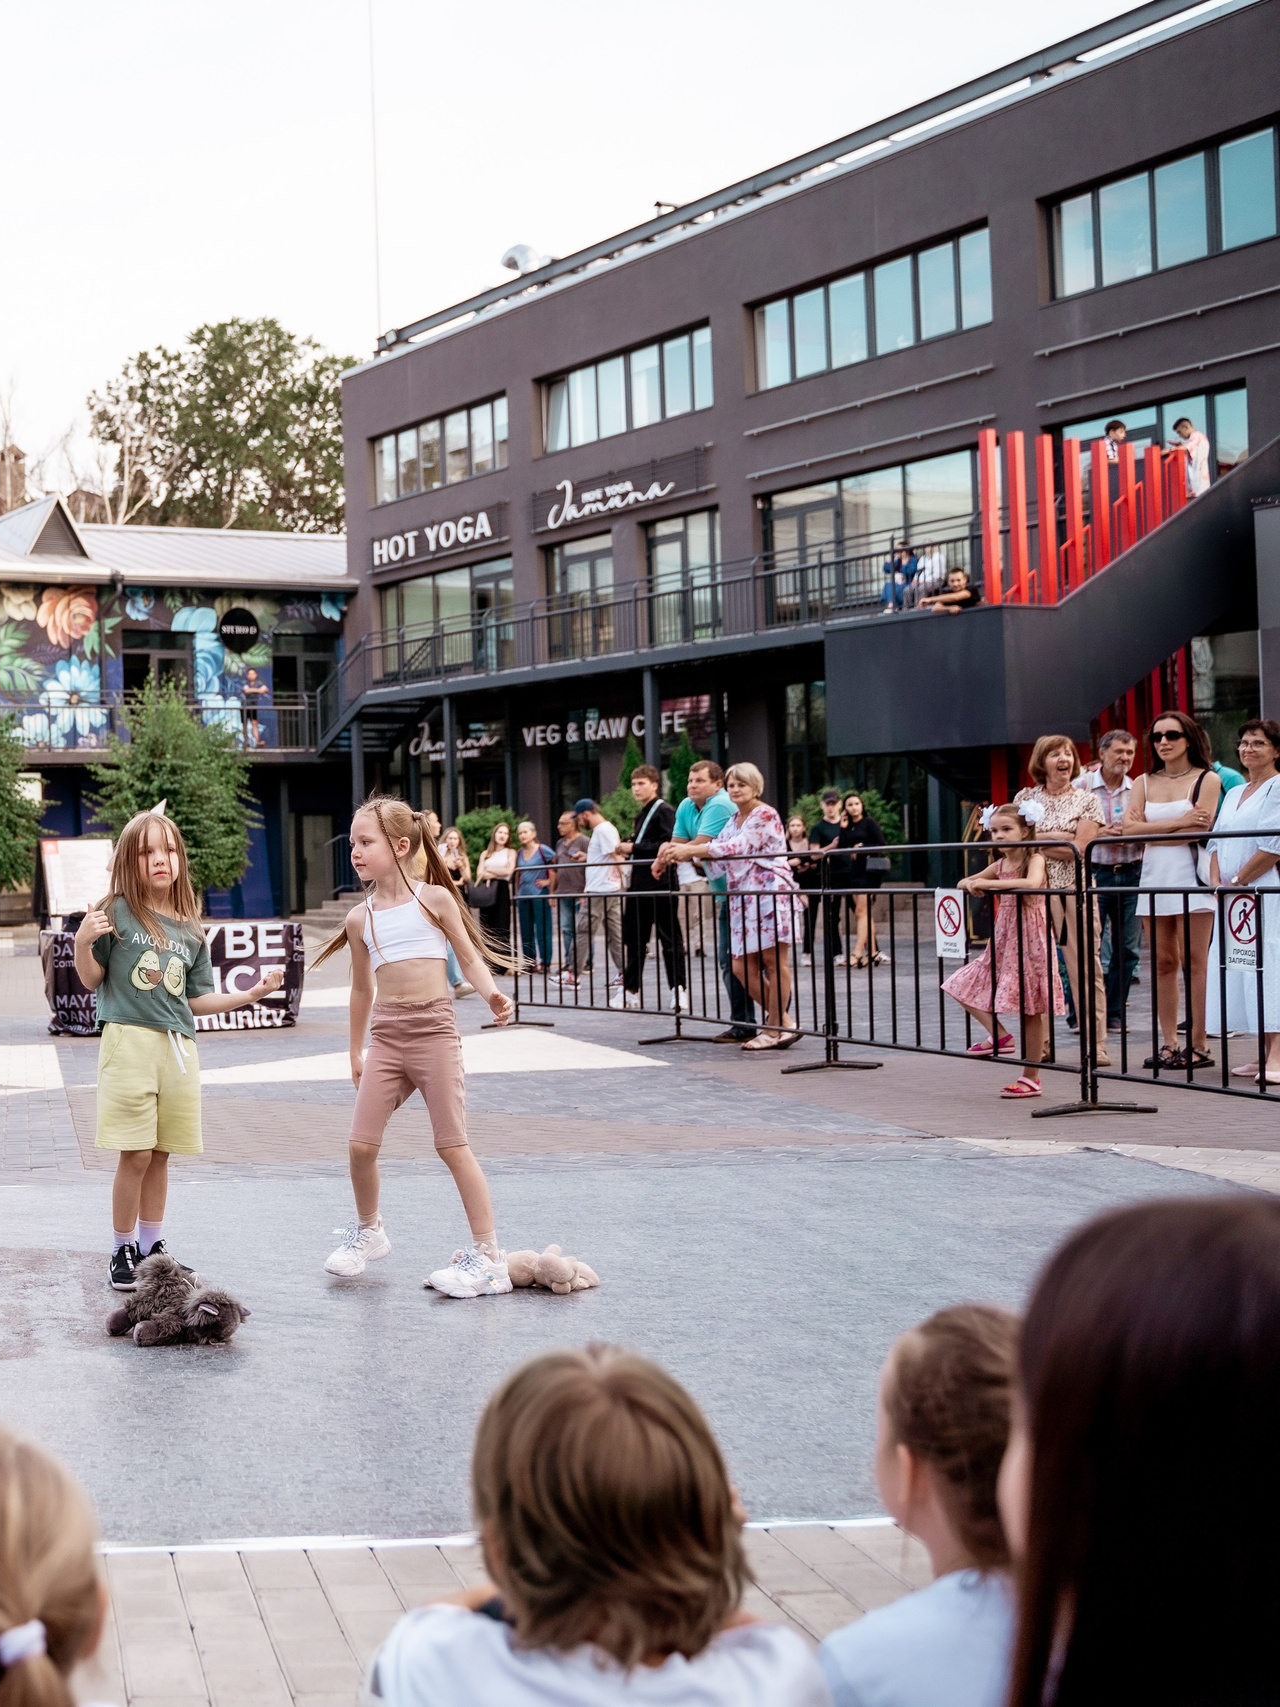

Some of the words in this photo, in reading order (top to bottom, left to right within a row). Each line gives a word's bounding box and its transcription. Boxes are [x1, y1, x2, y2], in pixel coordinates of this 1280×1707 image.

[373, 530, 419, 566] HOT
[423, 511, 492, 552] YOGA
[522, 724, 562, 748] VEG
[565, 722, 580, 744] &
[584, 711, 628, 741] RAW
[631, 709, 687, 737] CFE
[204, 924, 286, 959] YBE
[1232, 948, 1256, 957] ПРОХОД
[1227, 957, 1256, 967] ЗАПРЕЩЕ
[194, 1003, 286, 1030] munity
